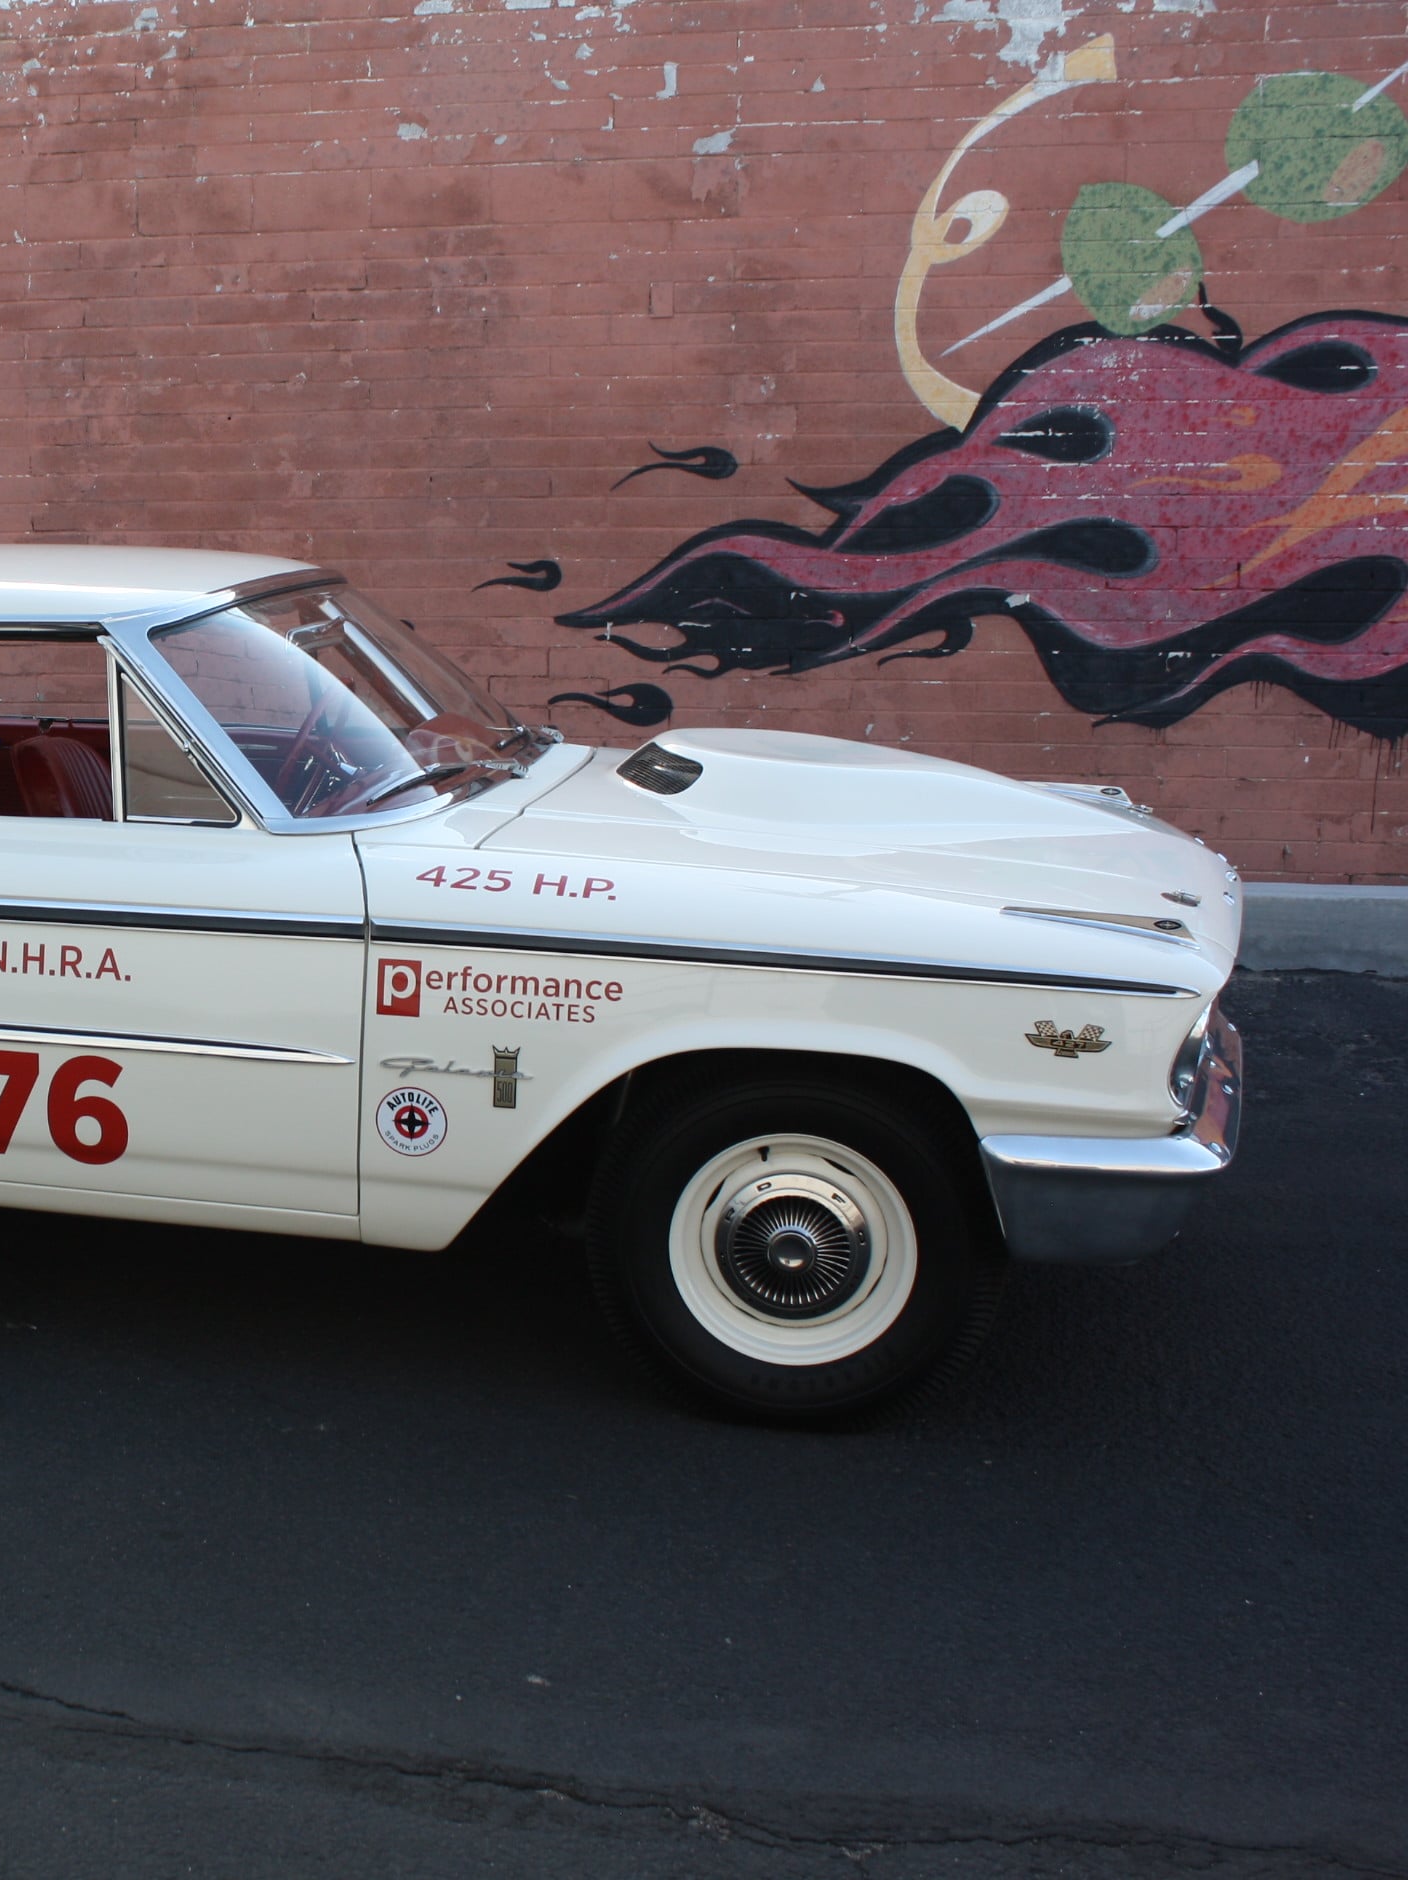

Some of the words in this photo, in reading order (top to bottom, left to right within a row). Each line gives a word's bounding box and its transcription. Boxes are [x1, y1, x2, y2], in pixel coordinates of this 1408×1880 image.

[416, 866, 513, 893] 425
[533, 873, 617, 901] H.P.
[443, 996, 596, 1024] ASSOCIATES
[386, 1091, 440, 1118] AUTOLITE
[496, 1081, 514, 1104] 500
[384, 1130, 412, 1152] SPARK
[412, 1133, 440, 1152] PLUGS
